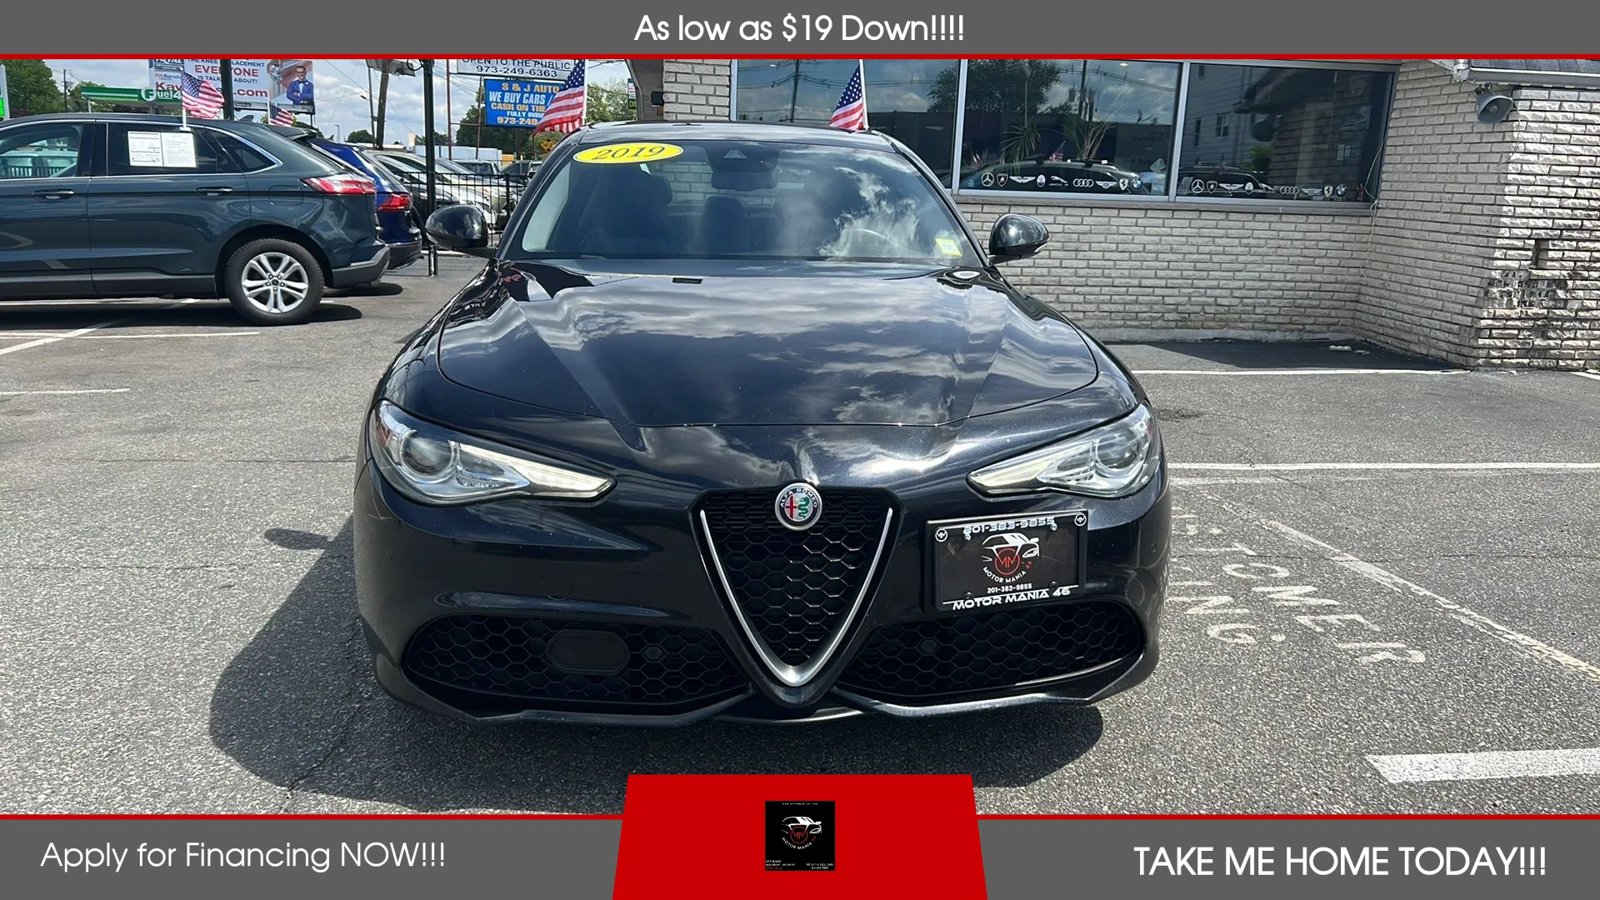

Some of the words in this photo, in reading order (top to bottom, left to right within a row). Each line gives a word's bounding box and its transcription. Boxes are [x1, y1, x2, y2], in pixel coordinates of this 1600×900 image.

[511, 59, 531, 67] THE
[533, 60, 571, 70] PUBLIC
[476, 65, 557, 78] 973-249-6363
[501, 83, 507, 91] S
[512, 83, 521, 91] &
[524, 84, 531, 92] J
[534, 84, 560, 93] AUTO
[489, 91, 502, 102] WE
[504, 92, 521, 104] BUY
[523, 93, 546, 105] CARS
[491, 102, 515, 111] CASH
[516, 103, 529, 111] ON
[531, 104, 547, 113] THE
[591, 146, 666, 160] 2019
[982, 566, 1004, 584] MOTOR
[1005, 569, 1027, 583] MANIA
[952, 597, 1002, 611] MOTOR
[1004, 588, 1050, 604] MANIA
[1052, 587, 1072, 597] 46
